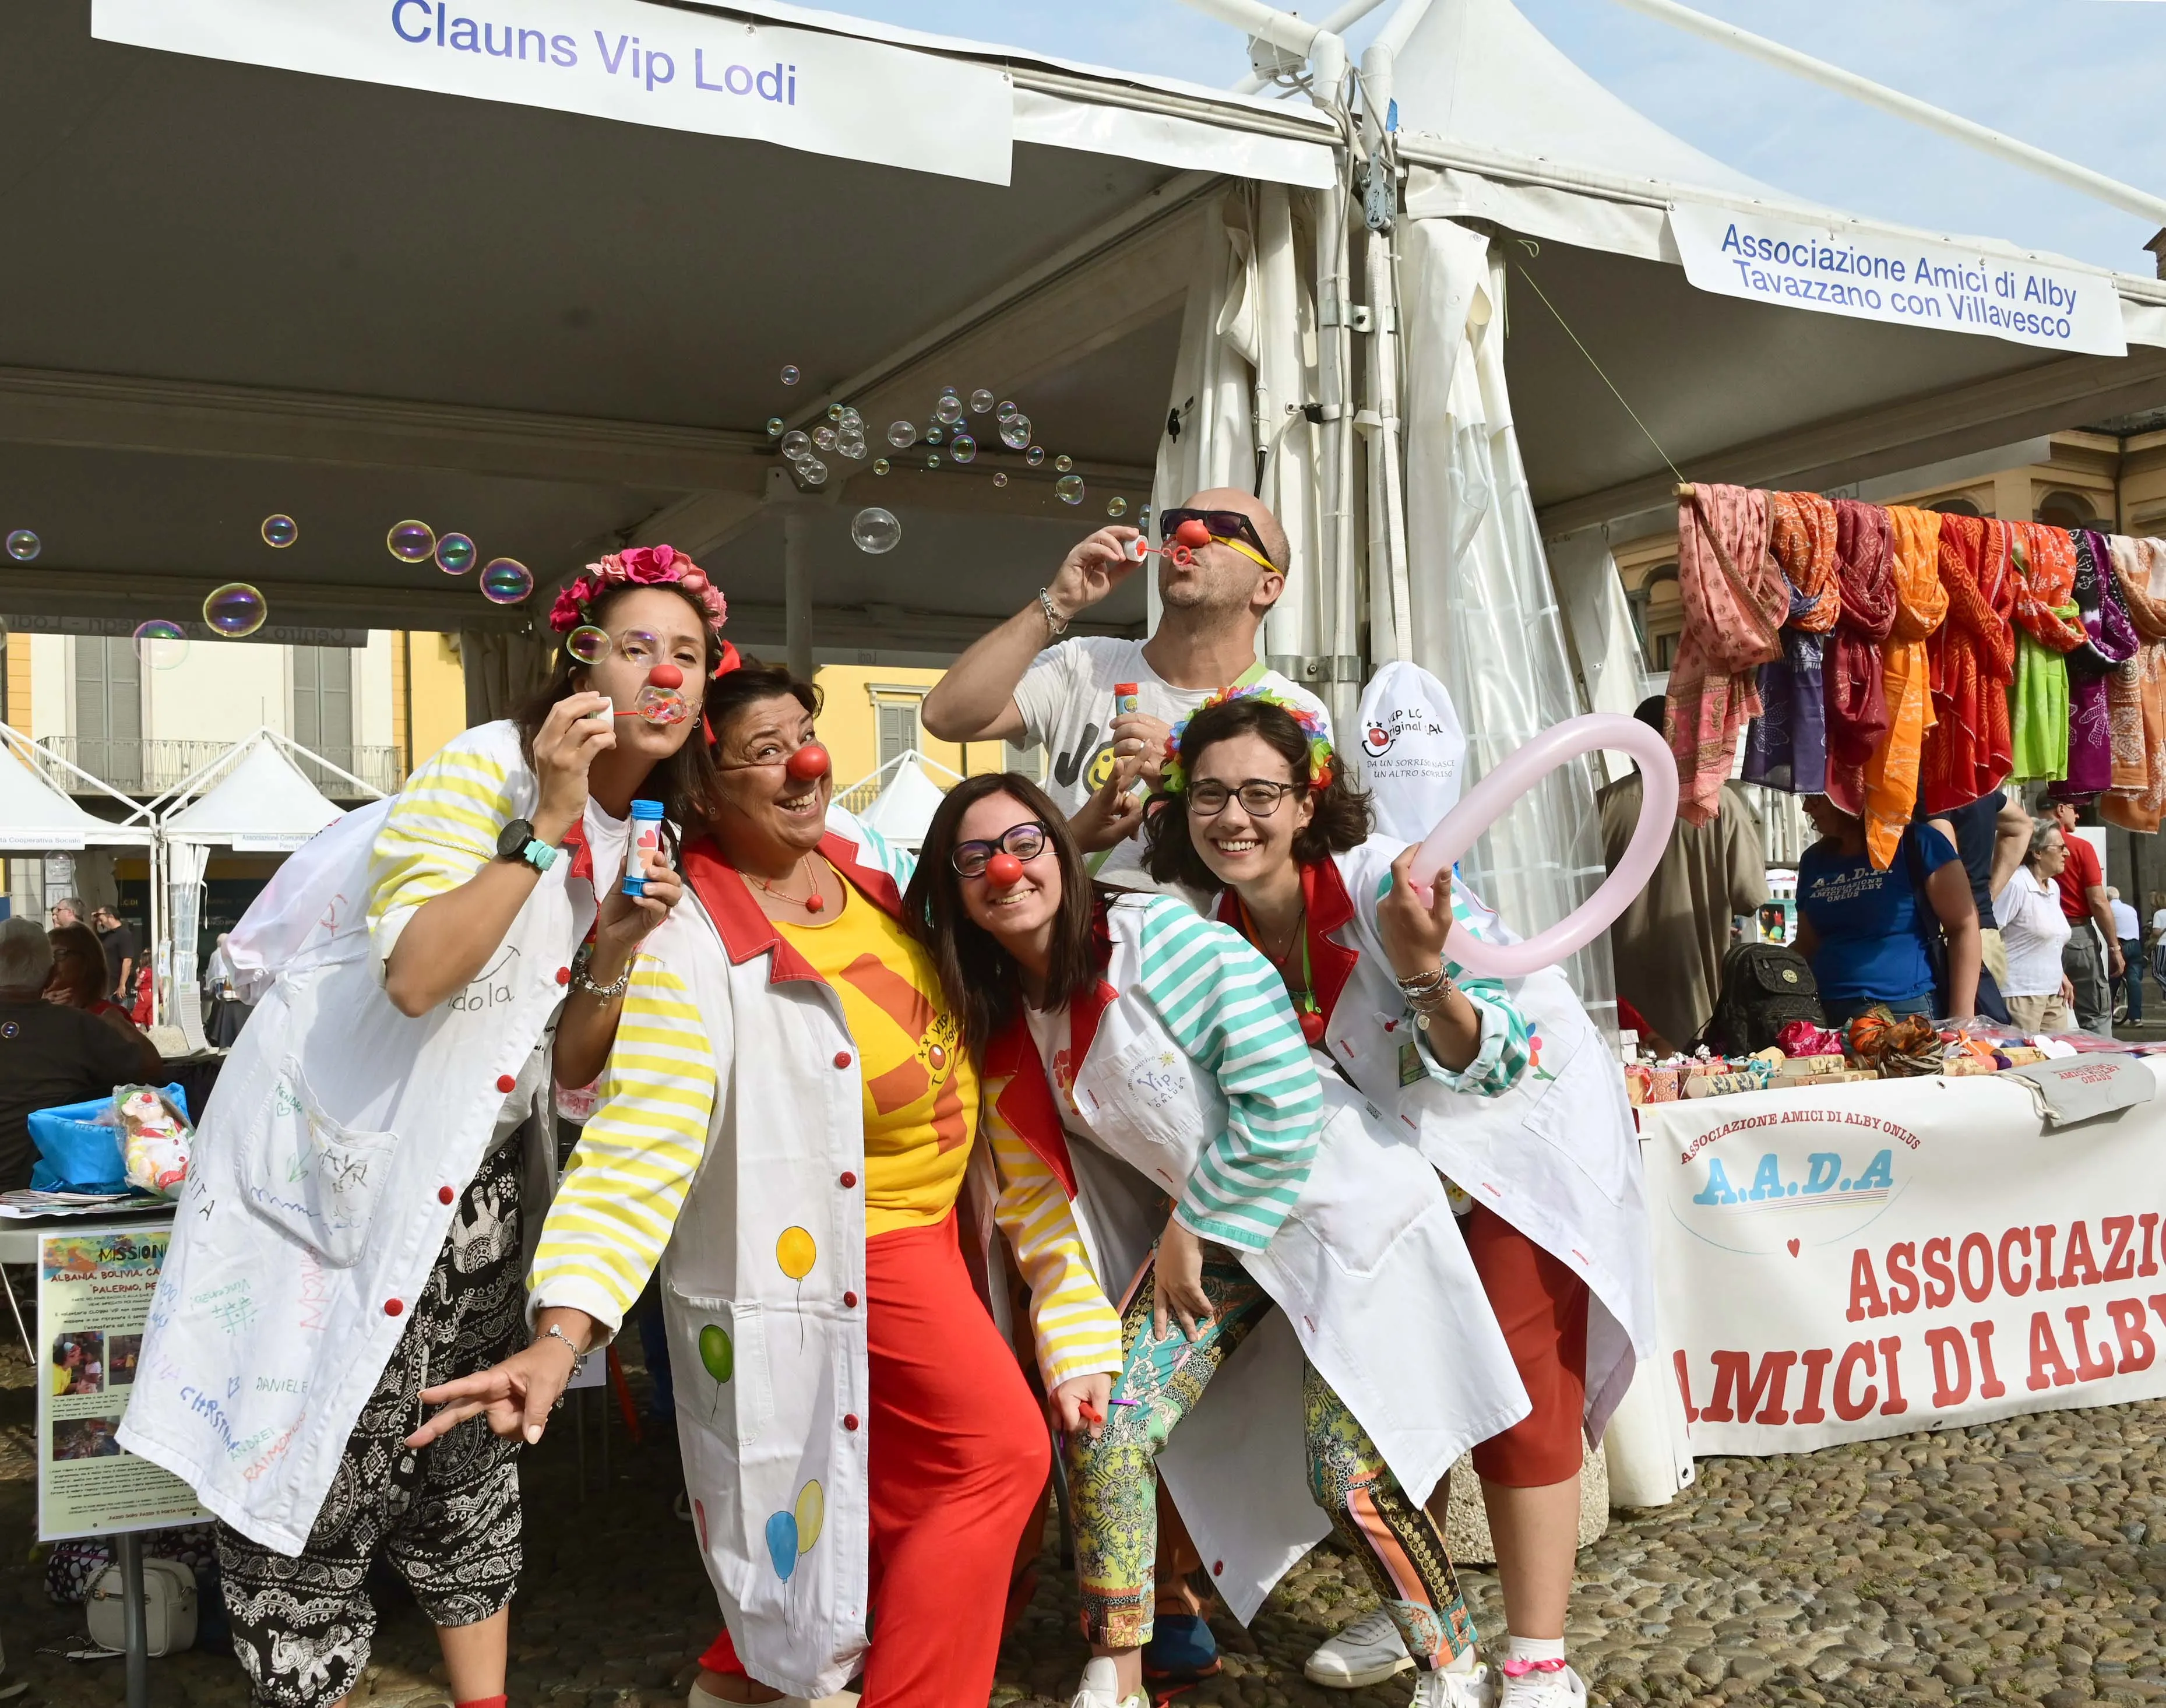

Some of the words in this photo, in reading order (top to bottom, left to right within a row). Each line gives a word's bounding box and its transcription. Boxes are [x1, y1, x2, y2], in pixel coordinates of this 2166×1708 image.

[391, 0, 578, 68] Clauns
[594, 30, 675, 91] Vip
[695, 48, 797, 106] Lodi
[1721, 224, 1906, 282] Associazione
[1914, 257, 1989, 294] Amici
[1995, 272, 2016, 300] di
[2023, 275, 2077, 316] Alby
[1732, 260, 1882, 311] Tavazzano
[1890, 293, 1942, 318] con
[1947, 294, 2072, 339] Villavesco
[1367, 759, 1377, 767] DA
[1380, 759, 1393, 767] UN
[1389, 769, 1419, 778] ALTRO
[1809, 888, 1843, 899] AMICI
[1853, 882, 1883, 892] ALBY
[1827, 891, 1859, 903] ONLUS
[1147, 1076, 1186, 1107] ITALIA
[1156, 1084, 1184, 1108] ONLUS
[1681, 1113, 1778, 1165] ASSOCIAZIONE
[1780, 1110, 1824, 1124] AMICI
[1827, 1110, 1842, 1123] DI
[1844, 1112, 1882, 1129] ALBY
[1883, 1121, 1921, 1151] ONLUS
[1845, 1212, 2166, 1323] ASSOCIAZI
[1924, 1319, 2005, 1408] DI
[256, 1376, 309, 1394] DANIELE
